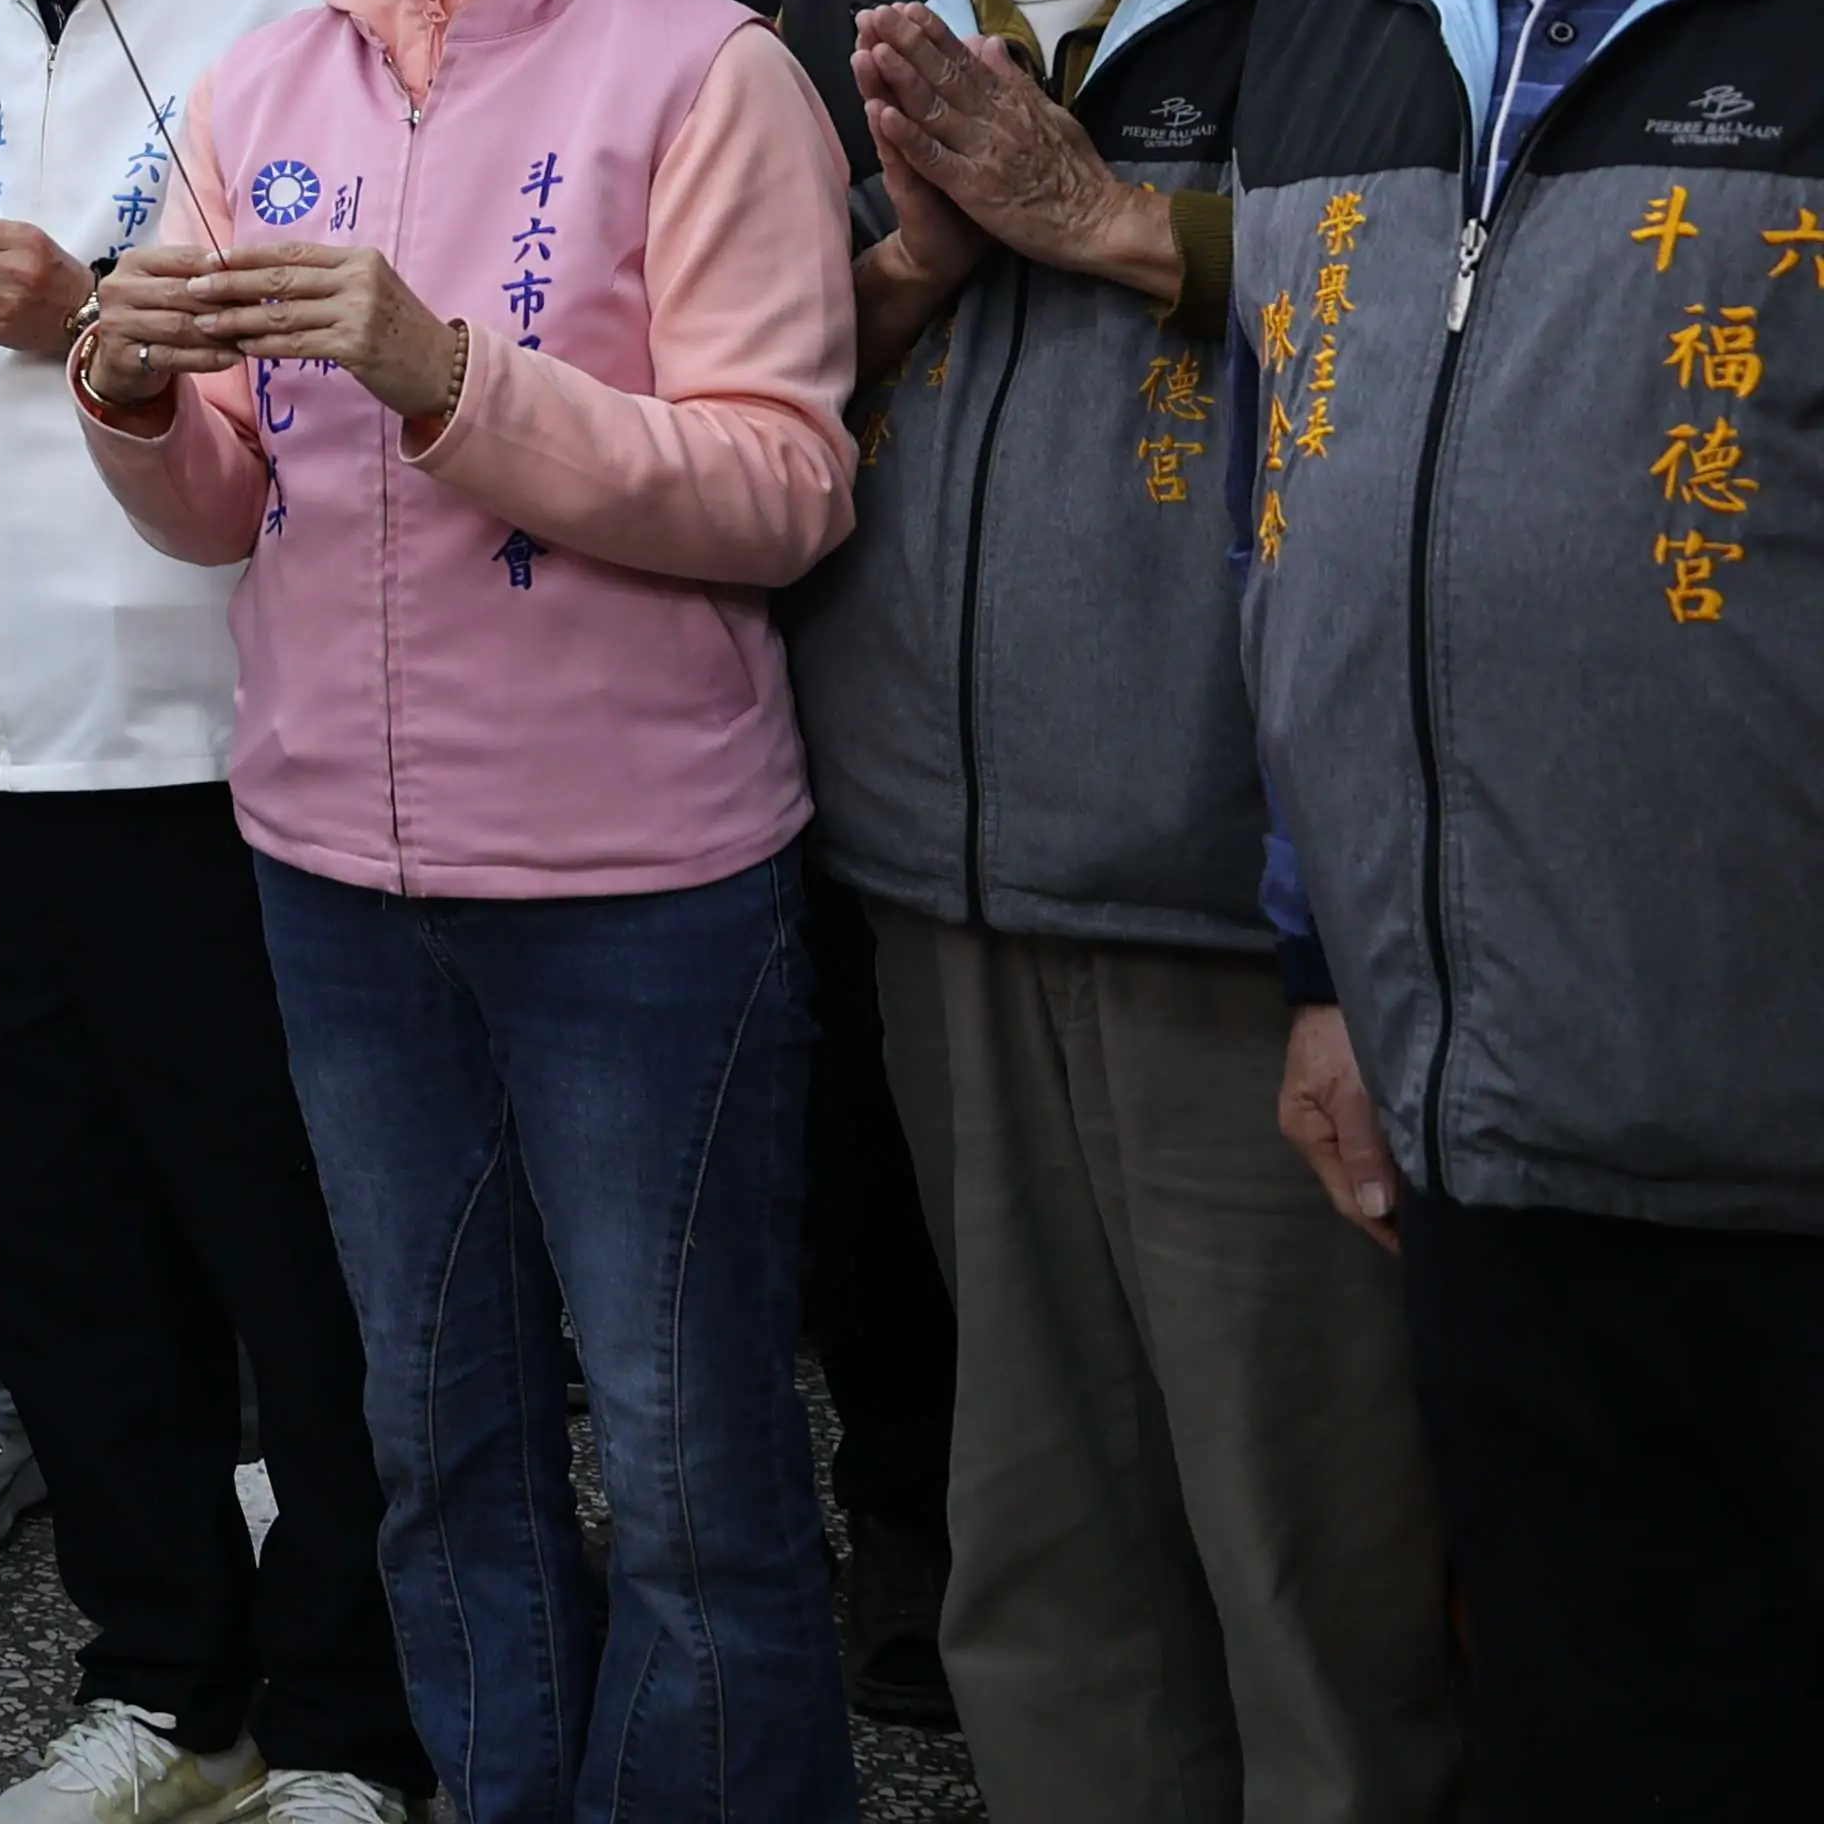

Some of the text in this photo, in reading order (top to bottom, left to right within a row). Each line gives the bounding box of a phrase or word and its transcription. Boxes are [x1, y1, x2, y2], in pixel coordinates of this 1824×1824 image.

[1121, 125, 1165, 139] PIERRE
[1644, 118, 1783, 140] PIERRE BALMAIN
[1297, 191, 1367, 461] 榮譽主委
[1649, 304, 1765, 623] 福德宮
